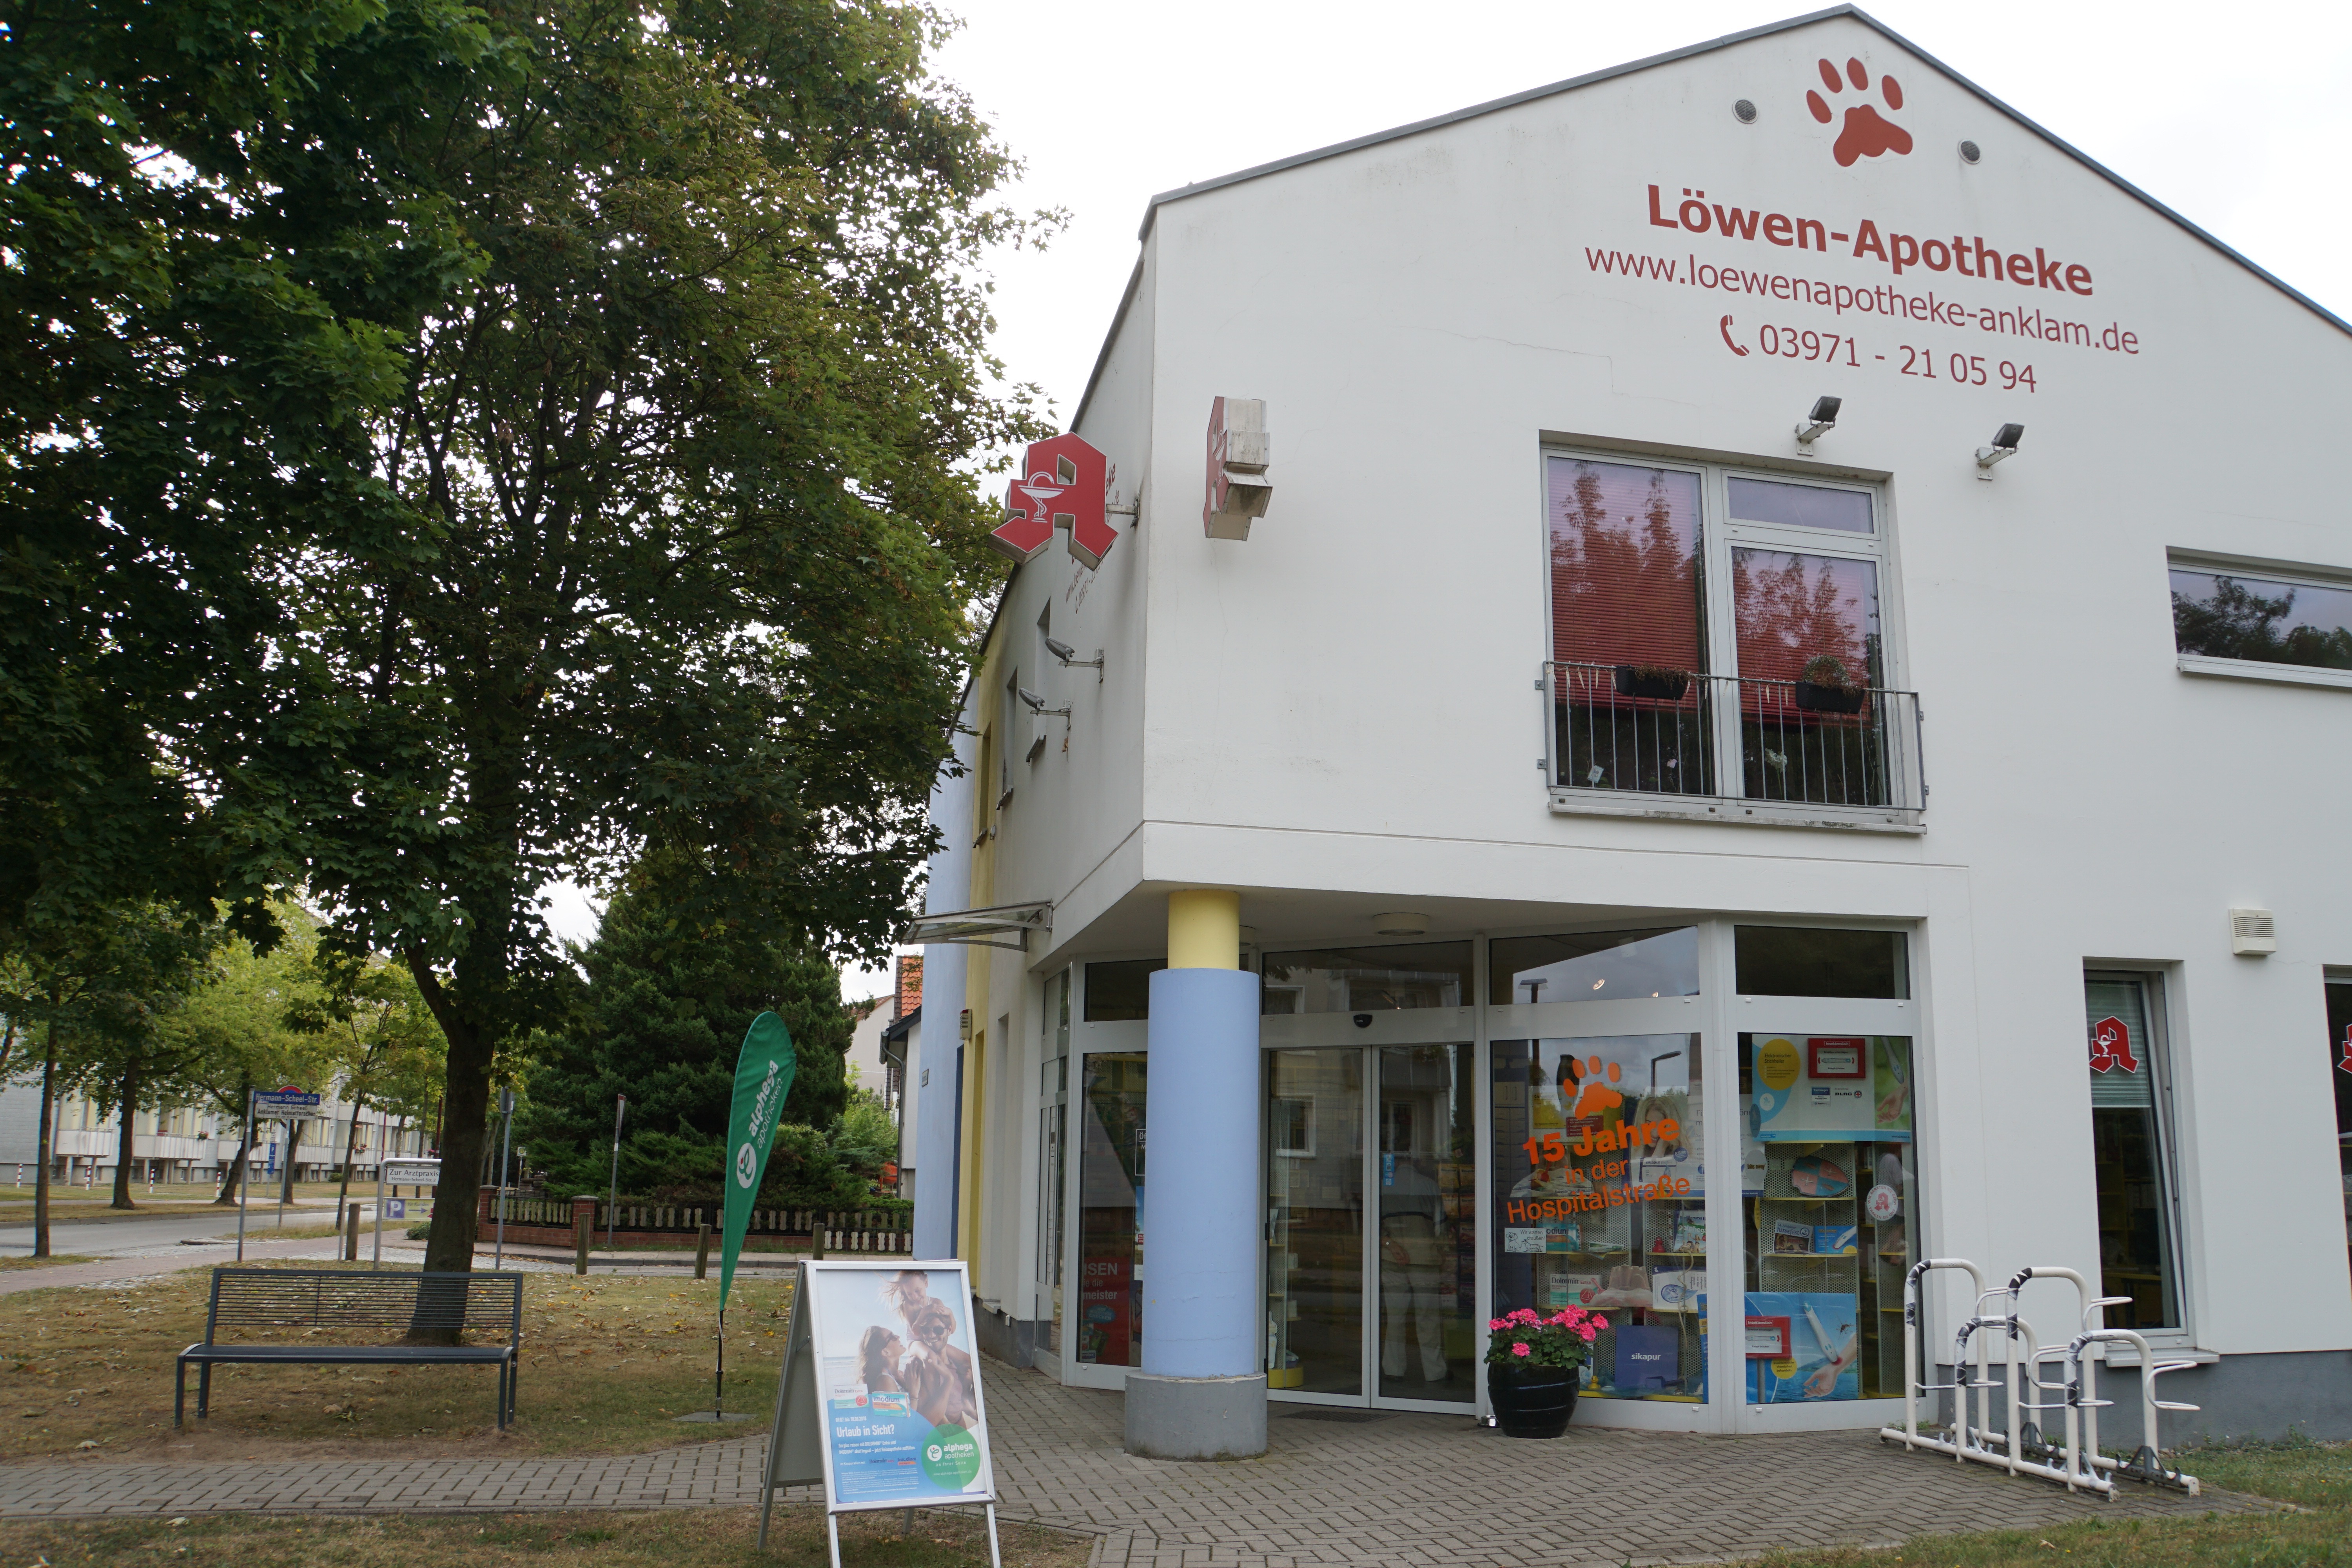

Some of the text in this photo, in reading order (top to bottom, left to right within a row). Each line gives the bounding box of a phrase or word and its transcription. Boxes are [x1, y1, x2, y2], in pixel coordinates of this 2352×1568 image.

[1648, 184, 2092, 296] Löwen-Apotheke
[1585, 247, 2139, 355] www.loewenapotheke-anklam.de
[1760, 324, 1860, 367] 03971
[1900, 346, 1936, 379] 21
[1950, 353, 1987, 386] 05
[1999, 361, 2036, 393] 94
[256, 1093, 318, 1103] Hermann-Scheel-Str.
[749, 1060, 779, 1137] alphega
[757, 1078, 783, 1149] apotheken
[1523, 1132, 1565, 1165] 15
[1573, 1118, 1680, 1156] Jahre
[1564, 1159, 1628, 1184] in der
[1507, 1175, 1690, 1223] Hospitalstraße
[1870, 1185, 1887, 1194] BERATEN
[1869, 1207, 1882, 1220] FRAGEN
[1092, 1278, 1103, 1287] die
[1631, 1352, 1661, 1362] sikapur
[837, 1424, 895, 1437] Urlaub in Sicht?
[944, 1443, 973, 1452] alphega
[945, 1451, 975, 1460] apotheken
